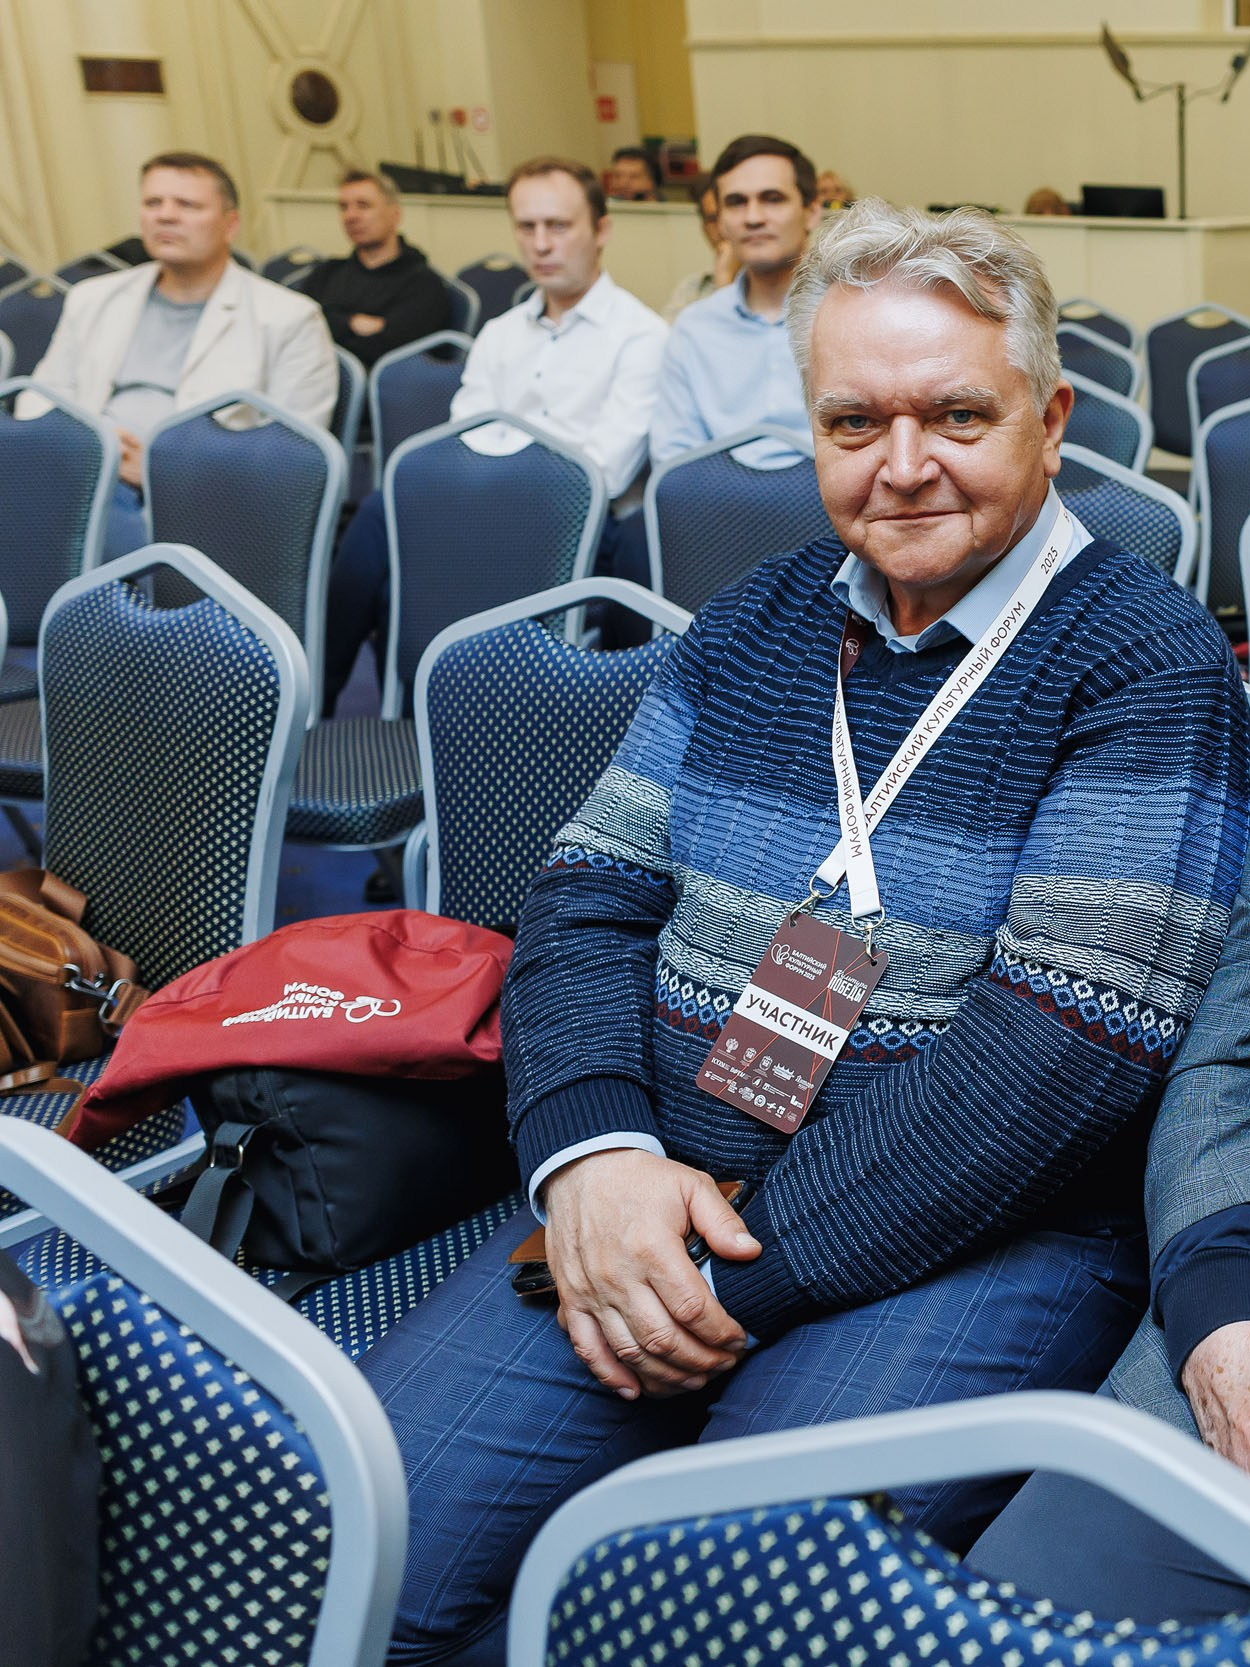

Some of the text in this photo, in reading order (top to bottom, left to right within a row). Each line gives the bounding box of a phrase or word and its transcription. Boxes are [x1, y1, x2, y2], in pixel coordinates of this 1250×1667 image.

[865, 546, 1059, 827] АЛТИЙСКИЙ КУЛЬТУРНЫЙ ФОРУМ 2025
[845, 803, 863, 858] ФОРУМ
[785, 962, 805, 977] ФОРУМ
[827, 975, 866, 1003] ПОБЕДЫ
[284, 982, 345, 1000] ФОРУМ
[746, 993, 839, 1051] УЧАСТНИК
